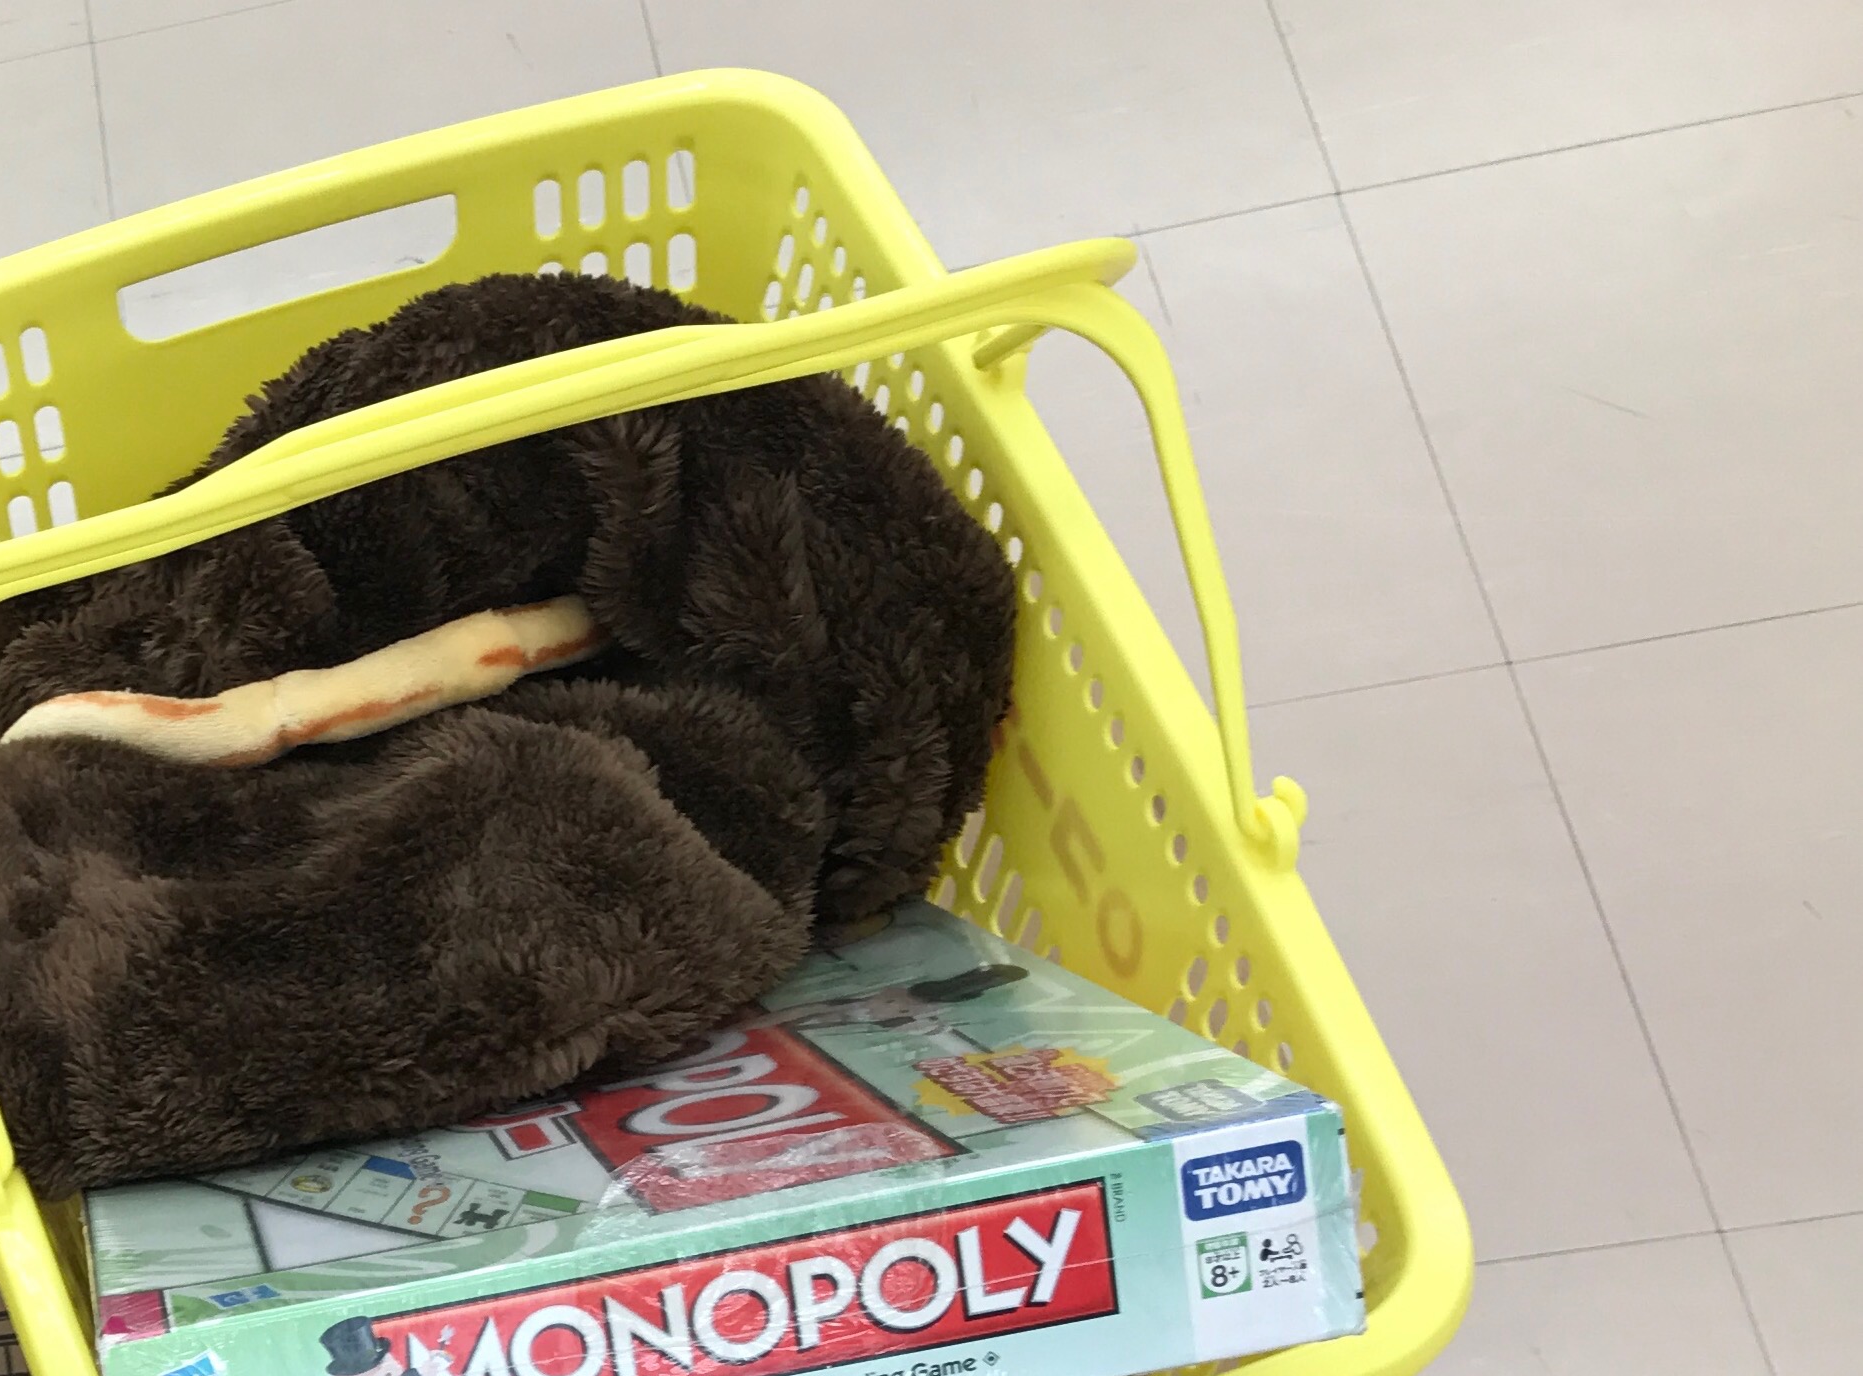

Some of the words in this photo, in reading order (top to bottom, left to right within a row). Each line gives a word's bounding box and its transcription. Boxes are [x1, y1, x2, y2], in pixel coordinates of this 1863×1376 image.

[1192, 1152, 1295, 1187] TAKARA
[1194, 1172, 1295, 1210] TOMY
[1210, 1264, 1241, 1288] 8+
